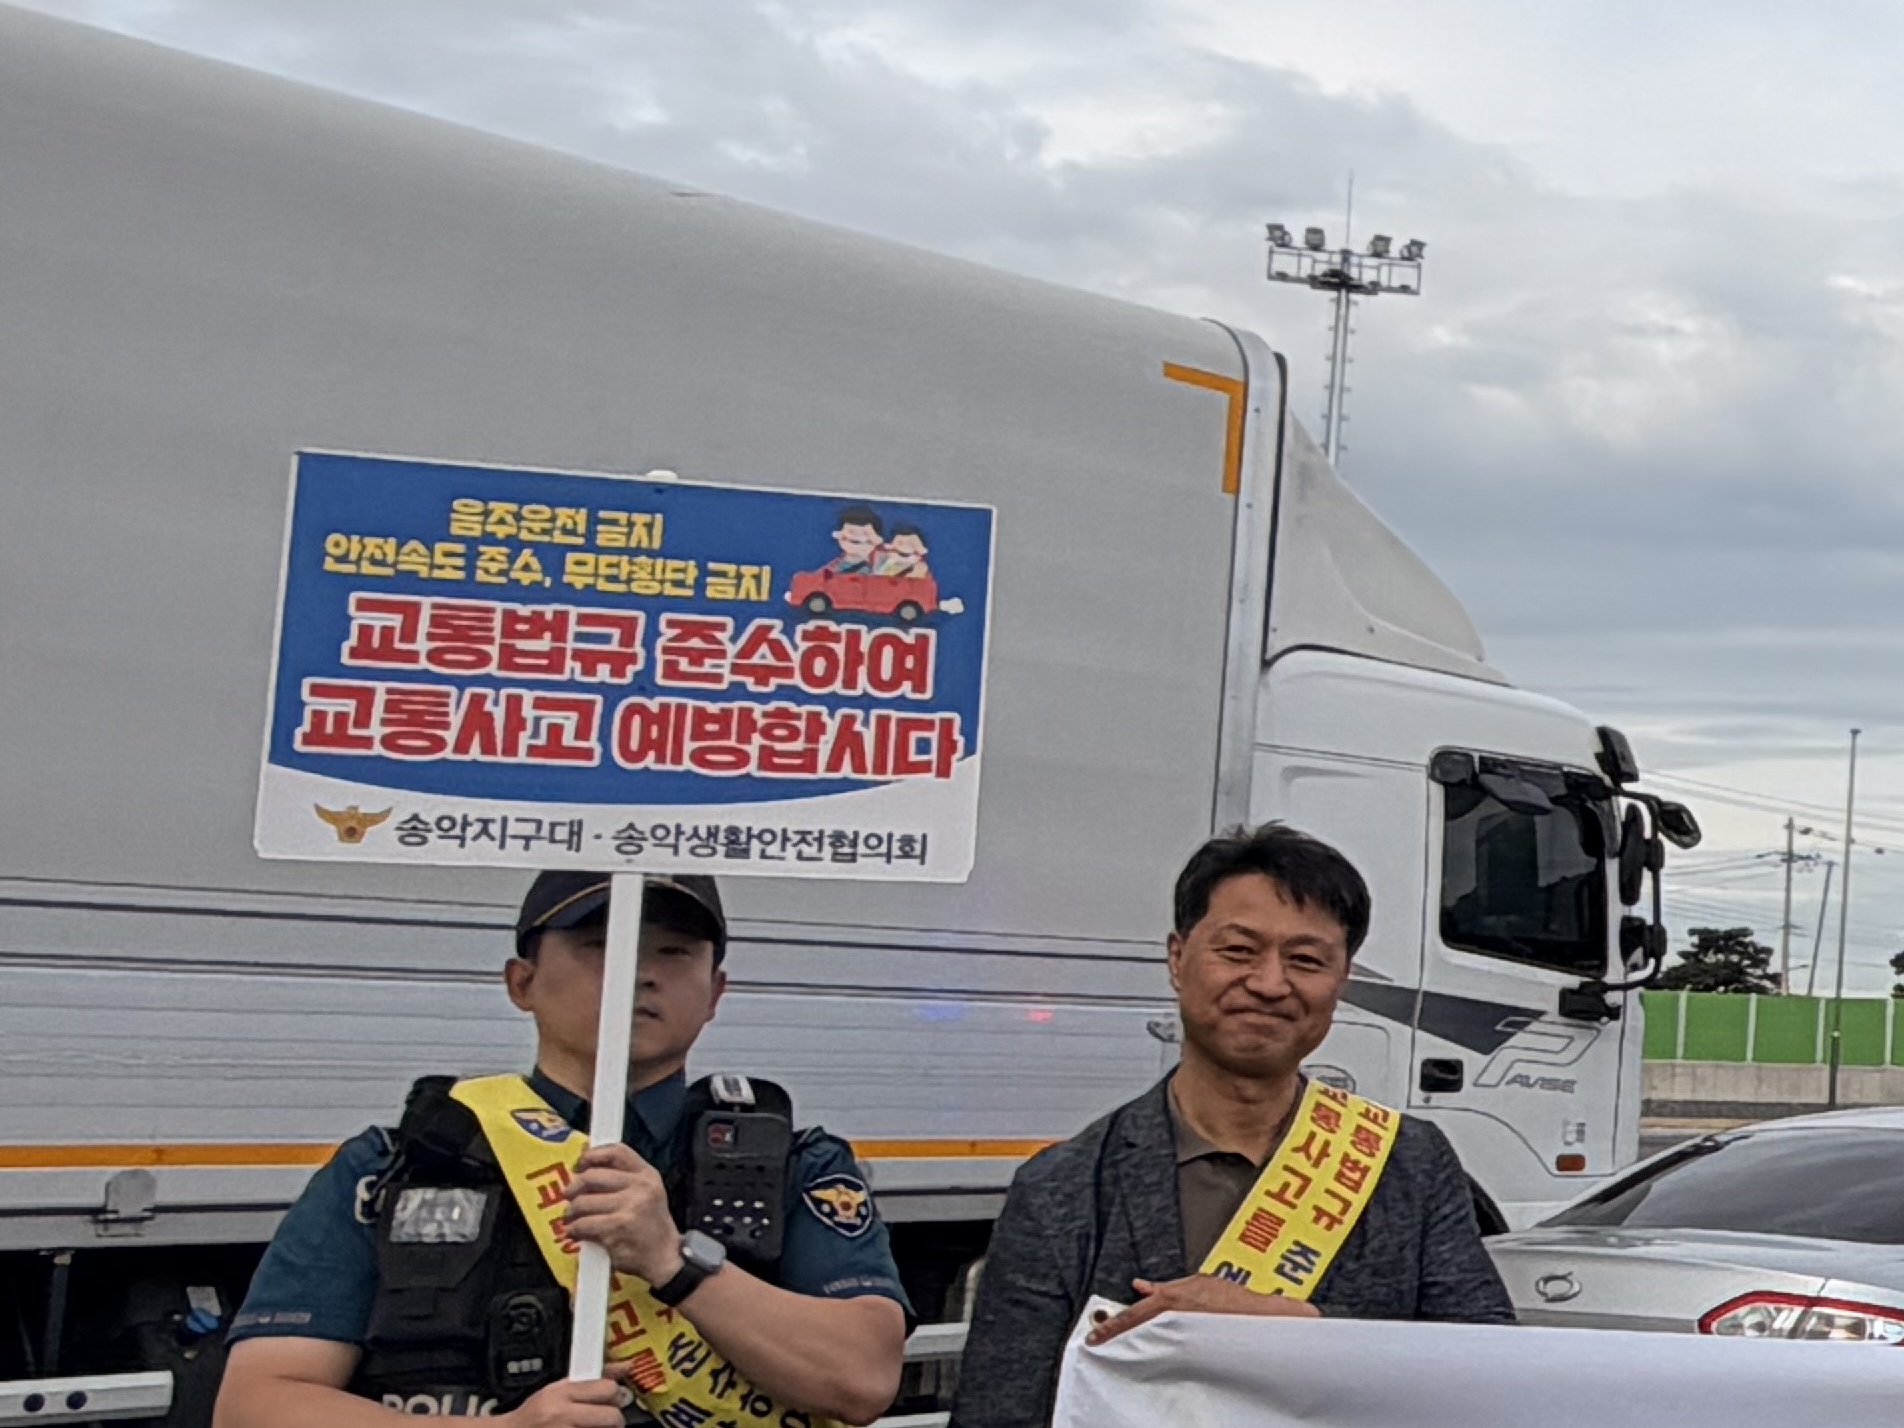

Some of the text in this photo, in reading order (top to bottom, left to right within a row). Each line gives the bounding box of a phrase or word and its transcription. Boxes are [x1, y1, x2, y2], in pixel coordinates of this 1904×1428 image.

[450, 498, 662, 551] 음주운전 금지
[323, 532, 772, 603] 안전속도 준수, 무단횡단 금지
[346, 594, 936, 697] 교통법규 준수하여
[299, 682, 961, 780] 교통사고 예방합시다
[394, 811, 929, 865] 송악지구대 송악생활안전협의회
